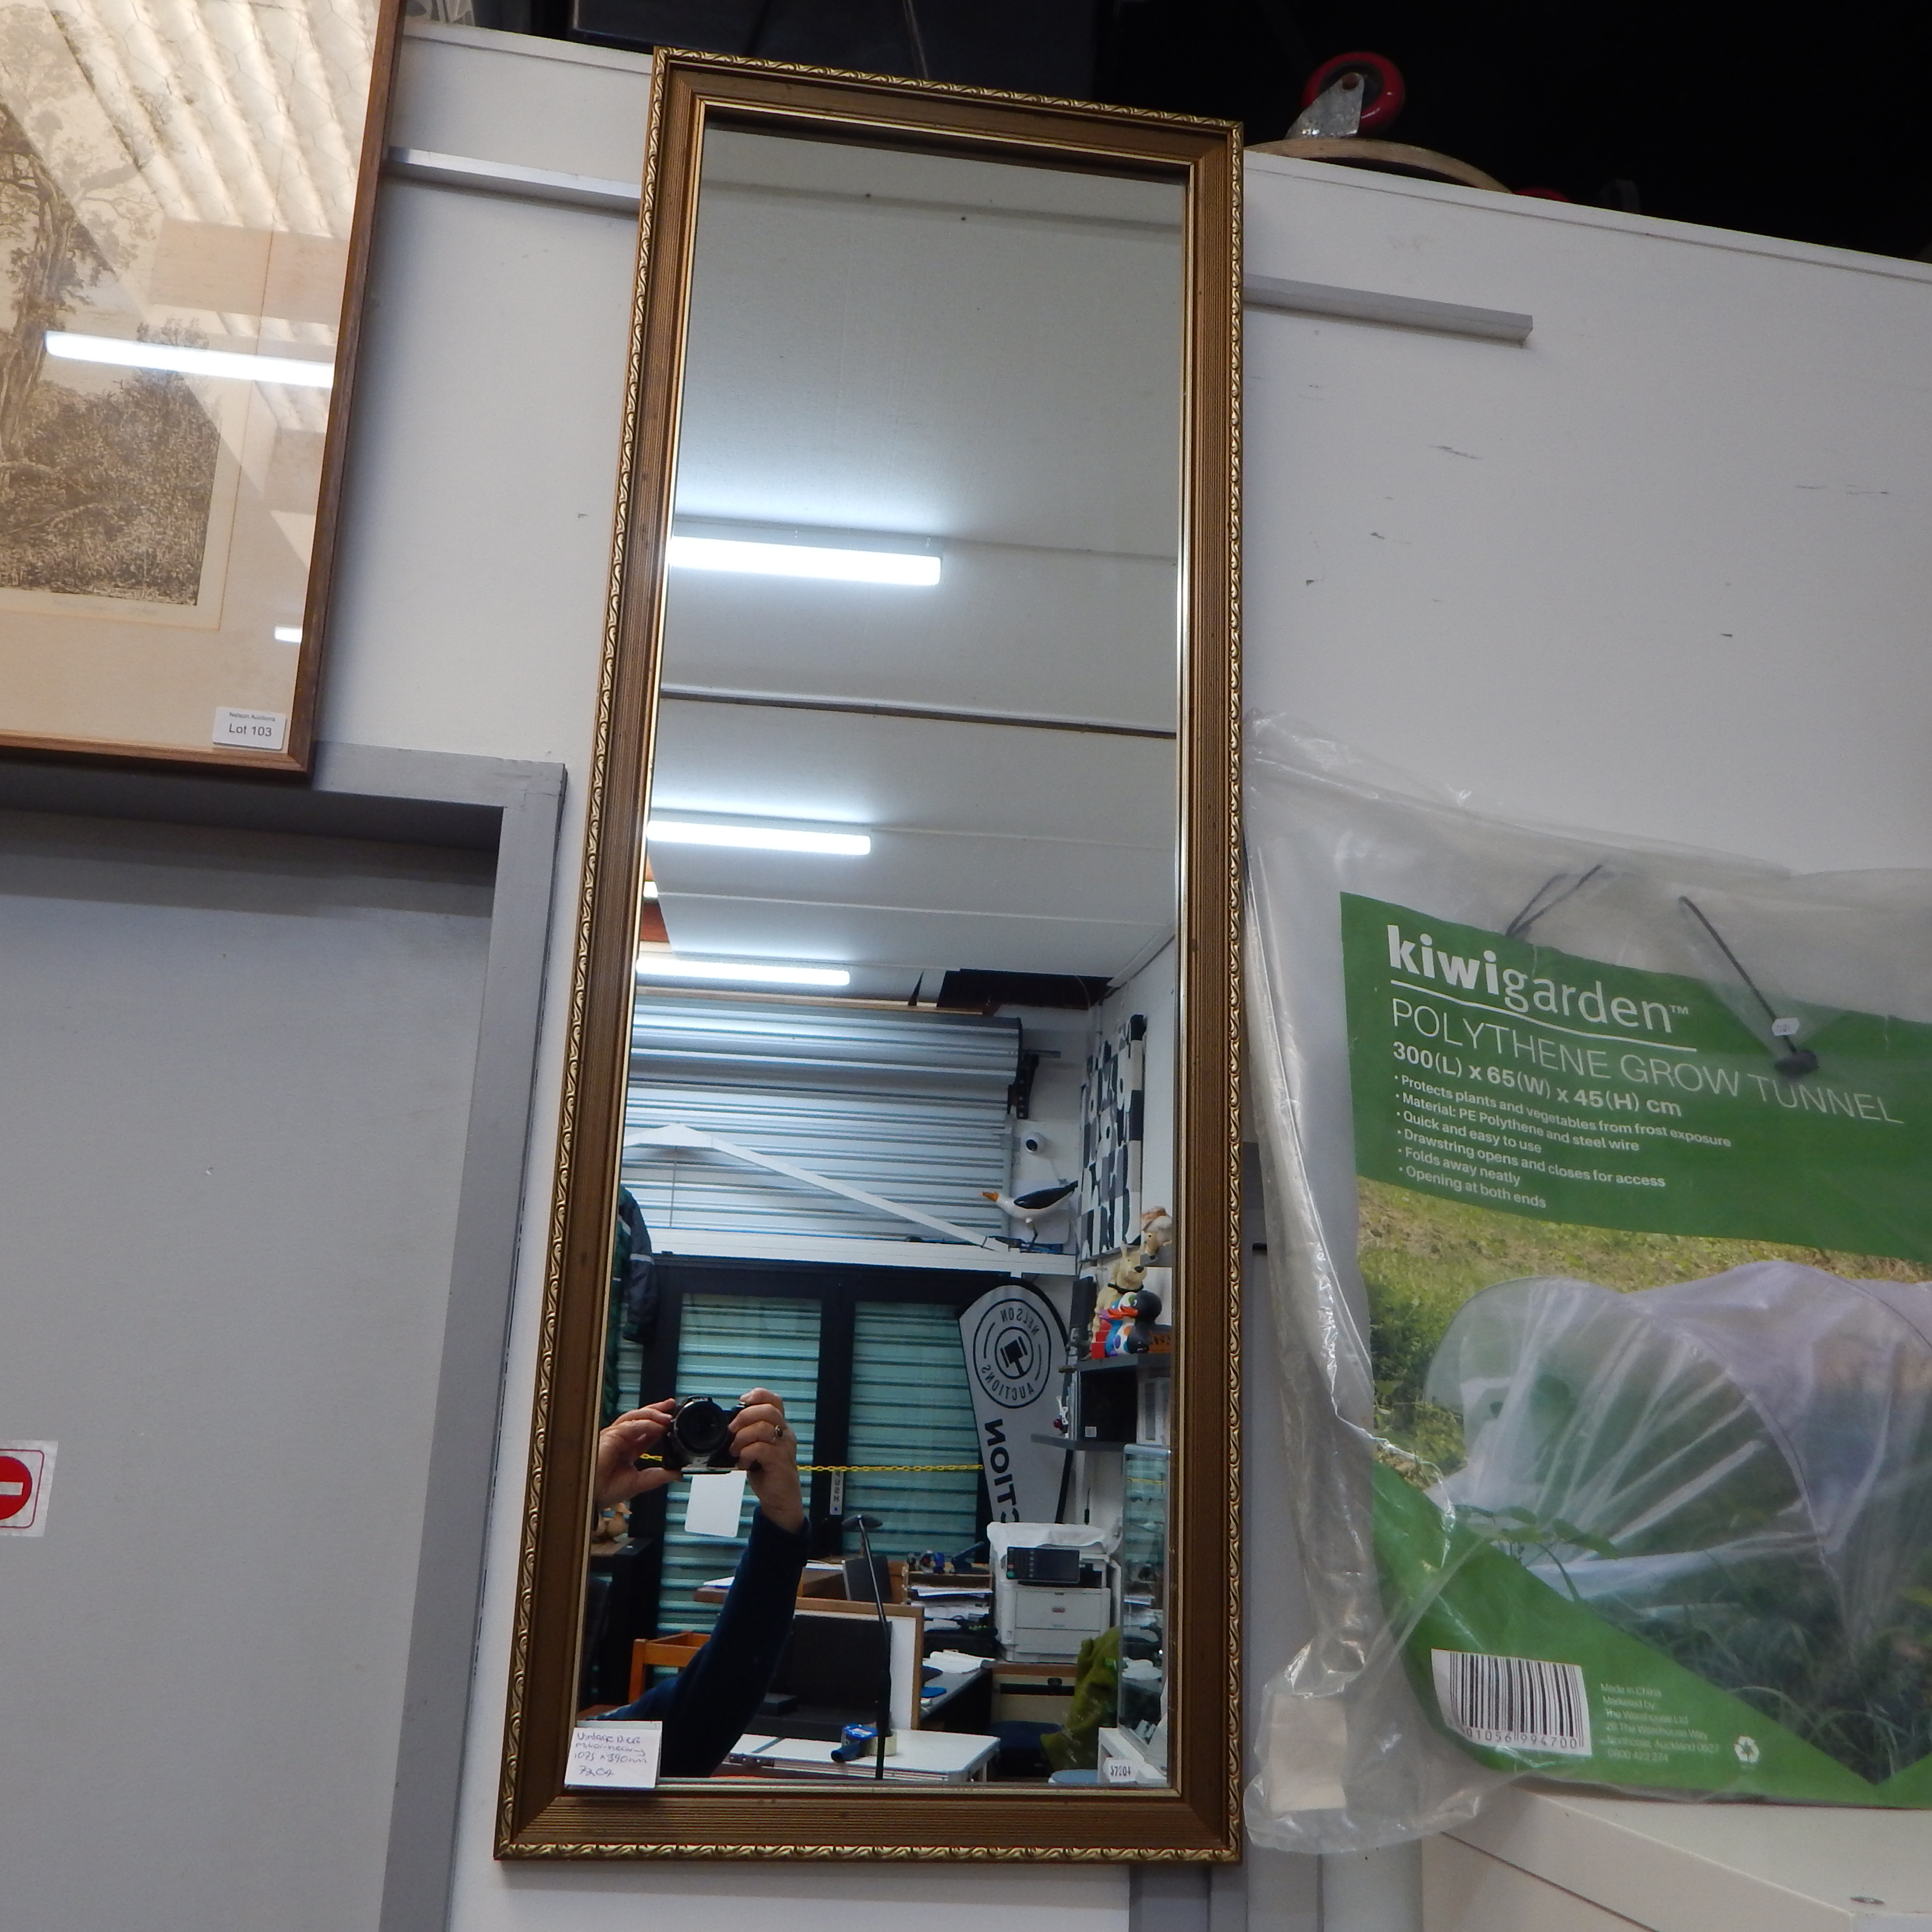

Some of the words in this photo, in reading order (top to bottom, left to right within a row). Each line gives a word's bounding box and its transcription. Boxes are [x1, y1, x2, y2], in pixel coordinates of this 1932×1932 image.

[229, 723, 247, 734] Lot
[252, 726, 272, 737] 103
[1393, 998, 1611, 1079] POLYTHENE
[1620, 1054, 1739, 1097] GROW
[1747, 1074, 1904, 1124] TUNNEL
[1393, 1041, 1462, 1078] 300(L)
[1469, 1065, 1483, 1081] x
[1487, 1066, 1551, 1100] 65(W)
[1557, 1088, 1569, 1103] x
[1574, 1090, 1639, 1111] 45(H)
[1646, 1099, 1682, 1117] cm
[1401, 1074, 1453, 1099] Protects
[1455, 1091, 1497, 1109] plants
[1499, 1101, 1524, 1115] and
[1526, 1107, 1597, 1131] vegetables
[1599, 1120, 1632, 1134] from
[1634, 1123, 1668, 1137] frost
[1670, 1129, 1732, 1147] exposure
[1403, 1092, 1456, 1117] Material:
[1459, 1109, 1476, 1121] PE
[1479, 1112, 1545, 1137] Polythene
[1546, 1128, 1570, 1143] and
[1573, 1136, 1606, 1148] steel
[1608, 1139, 1640, 1152] wire
[1403, 1110, 1440, 1131] Quick
[1442, 1123, 1467, 1137] and
[1469, 1129, 1500, 1147] easy
[1503, 1135, 1517, 1147] to
[1519, 1140, 1542, 1153] use
[1404, 1128, 1475, 1159] Drawstring
[1477, 1149, 1519, 1166] opens
[1521, 1159, 1546, 1172] and
[1548, 1164, 1591, 1180] closes
[1593, 1169, 1613, 1182] for
[1616, 1174, 1666, 1187] access
[1405, 1147, 1441, 1166] Folds
[1442, 1158, 1478, 1177] away
[1480, 1169, 1521, 1187] neatly
[1406, 1166, 1463, 1192] Opening
[1465, 1181, 1478, 1193] at
[1480, 1183, 1511, 1200] both
[1513, 1193, 1547, 1209] ends
[1520, 1734, 1577, 1749] 994700
